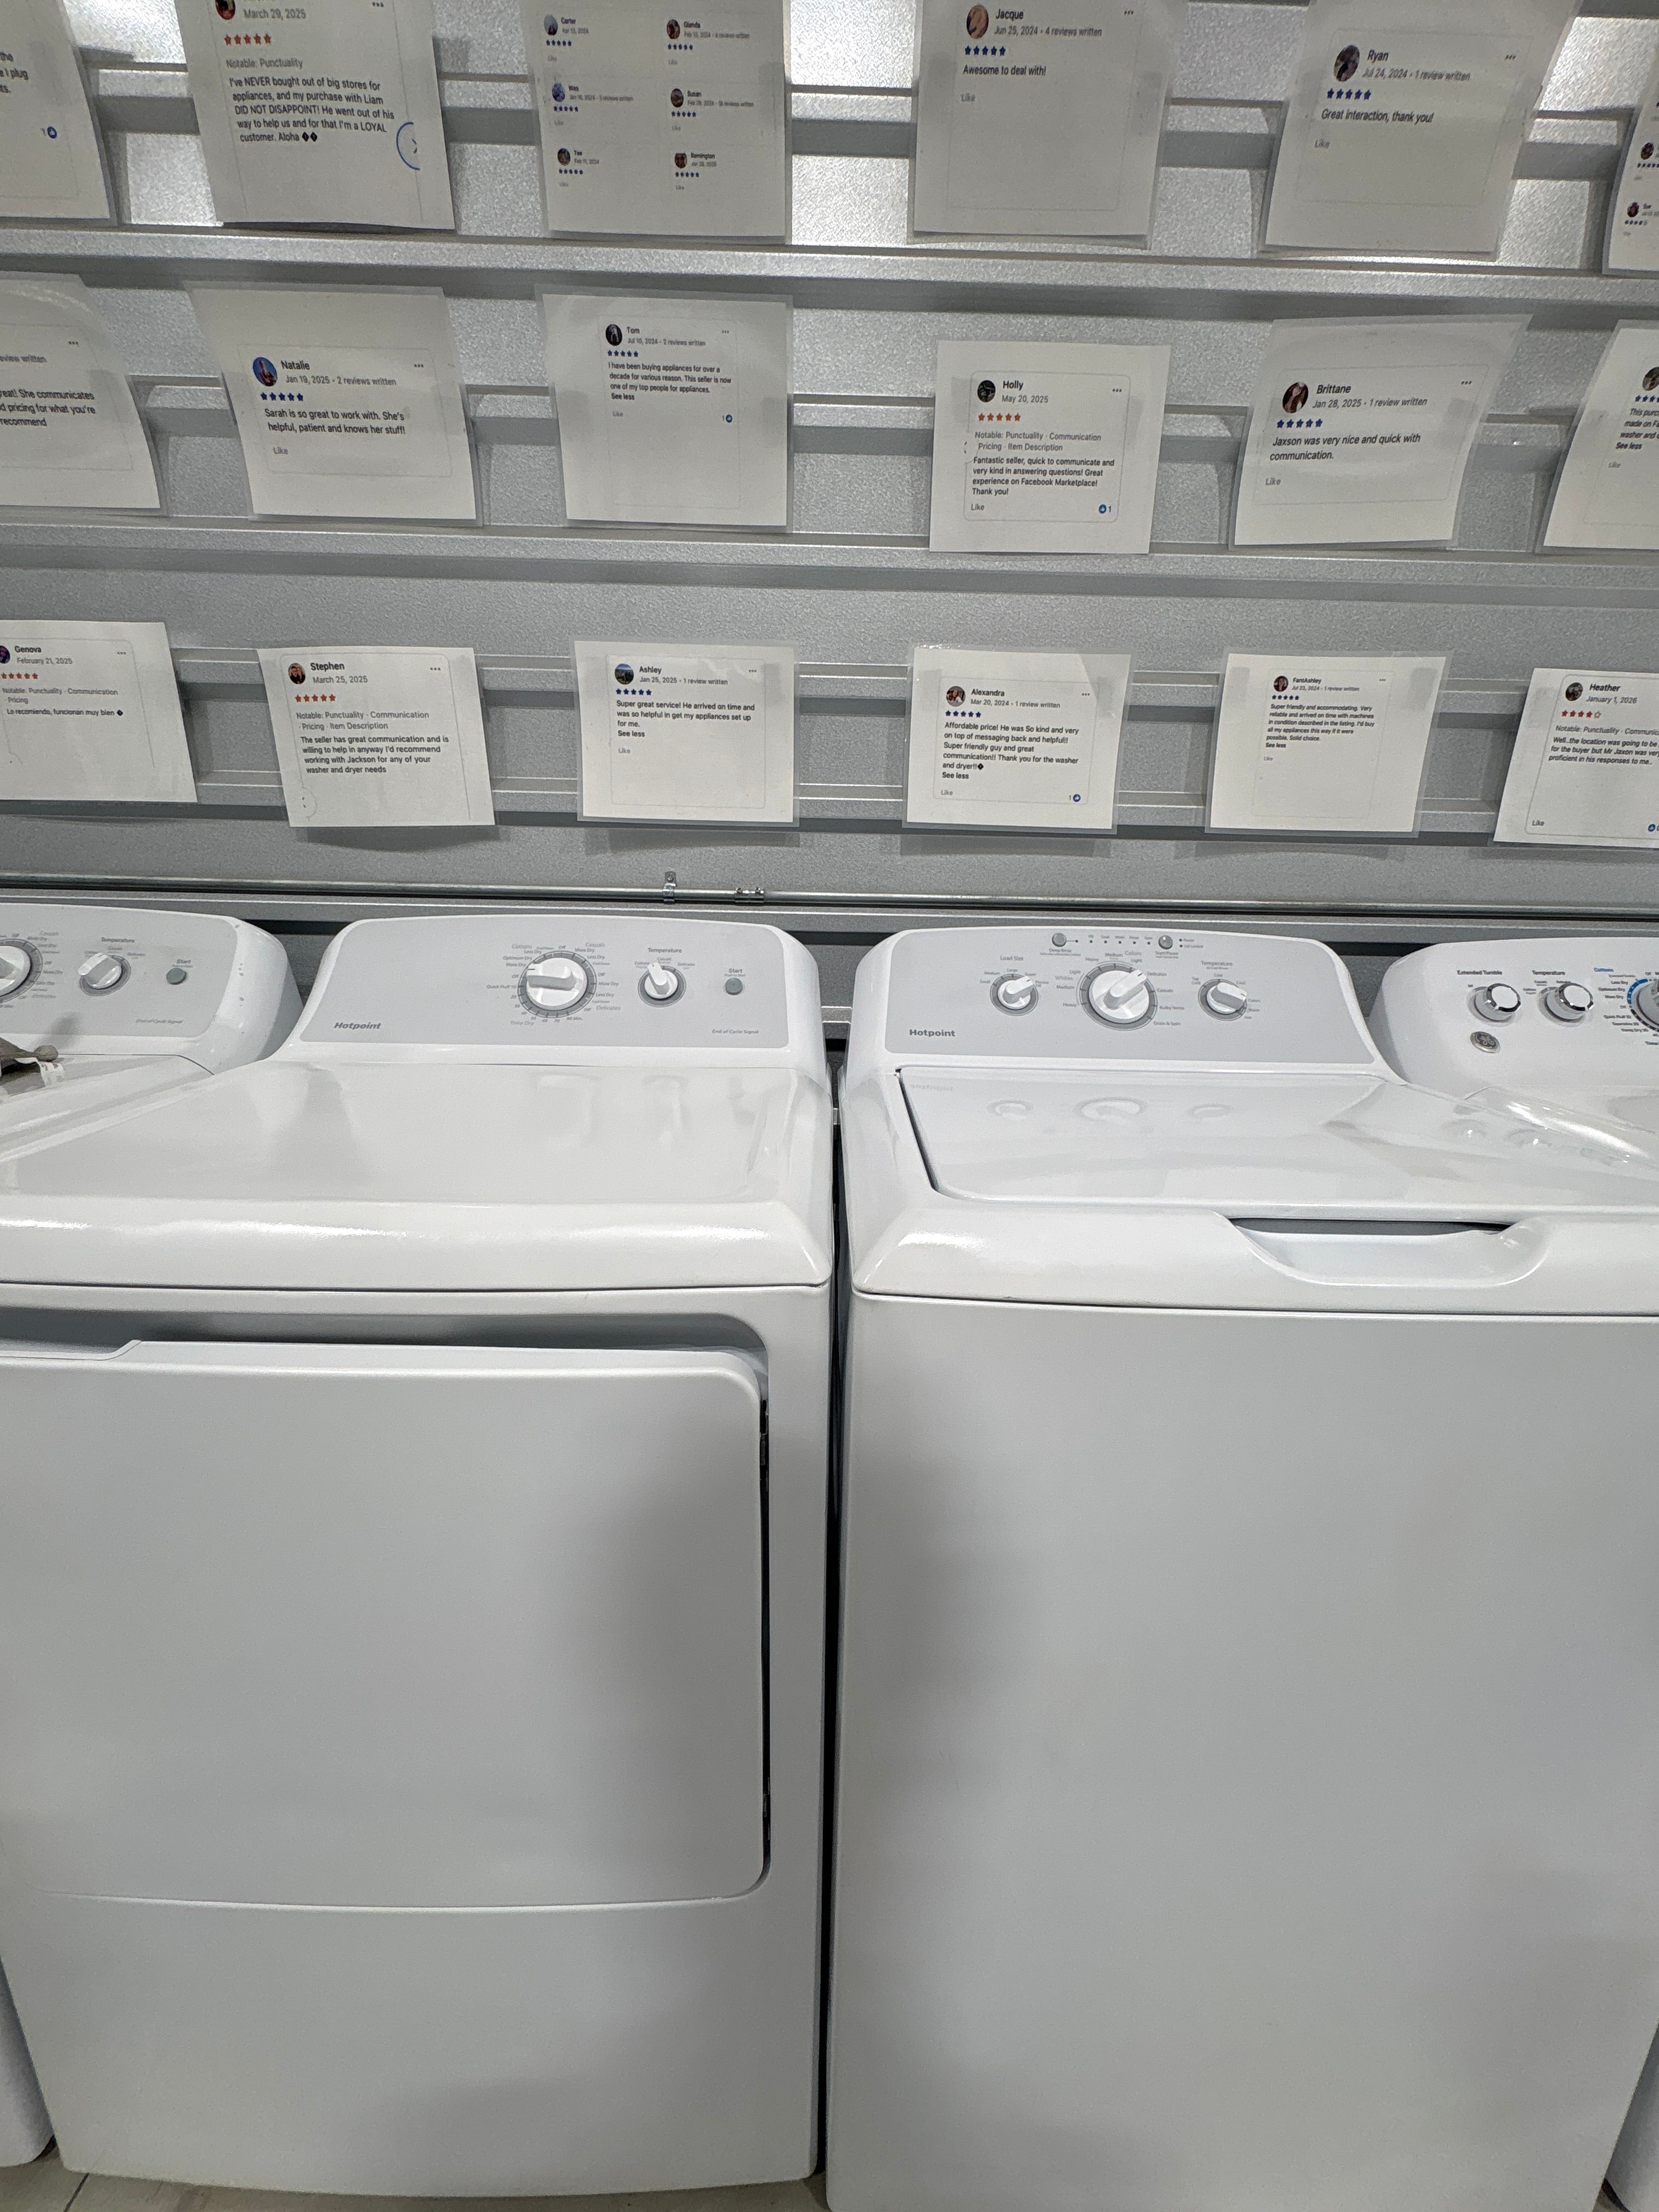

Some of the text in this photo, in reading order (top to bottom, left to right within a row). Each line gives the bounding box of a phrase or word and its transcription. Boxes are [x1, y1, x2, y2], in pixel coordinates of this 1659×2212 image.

[244, 9, 269, 19] March
[285, 8, 306, 19] 2025
[996, 9, 1024, 21] Jacque
[1367, 49, 1389, 63] Ryan
[963, 65, 1046, 76] Awesome to deal with!
[229, 77, 380, 91] I've NEVER bought out of big stores for
[235, 104, 394, 119] DID NOT DISAPPOINT! He went out of his
[1322, 109, 1434, 125] Great interaction, thank you!
[281, 360, 310, 370] Natalie
[642, 363, 661, 372] buying
[300, 375, 311, 385] 19,
[311, 375, 330, 384] 2025
[1003, 380, 1023, 391] Holly
[19, 389, 94, 399] She communicates
[1317, 384, 1351, 394] Brittane
[1002, 395, 1016, 404] May
[1018, 395, 1028, 404] 20,
[1312, 400, 1326, 408] Jan
[1328, 399, 1339, 409] 28,
[1342, 399, 1362, 408] 2025
[1375, 398, 1400, 407] review
[1401, 397, 1427, 405] written
[8, 404, 95, 415] pricing for what you're
[264, 408, 287, 417] Sarah
[289, 409, 296, 417] is
[309, 411, 330, 420] great
[341, 411, 360, 419] work
[362, 411, 381, 420] with.
[382, 411, 404, 420] She's
[1273, 437, 1301, 446] Jaxson
[1323, 437, 1341, 446] very
[1342, 435, 1359, 444] nice
[1361, 435, 1378, 444] and
[1379, 434, 1401, 445] quick
[1403, 433, 1420, 442] with
[978, 443, 1002, 452] Pricing
[1025, 443, 1063, 452] Description
[1006, 456, 1025, 465] seller,
[1028, 457, 1045, 465] quick
[1270, 450, 1333, 461] communication.
[973, 477, 1009, 486] experience
[1055, 478, 1097, 487] Marketplace!
[311, 662, 345, 672] Stephen
[639, 666, 662, 675] Ashley
[345, 766, 363, 774] dryer
